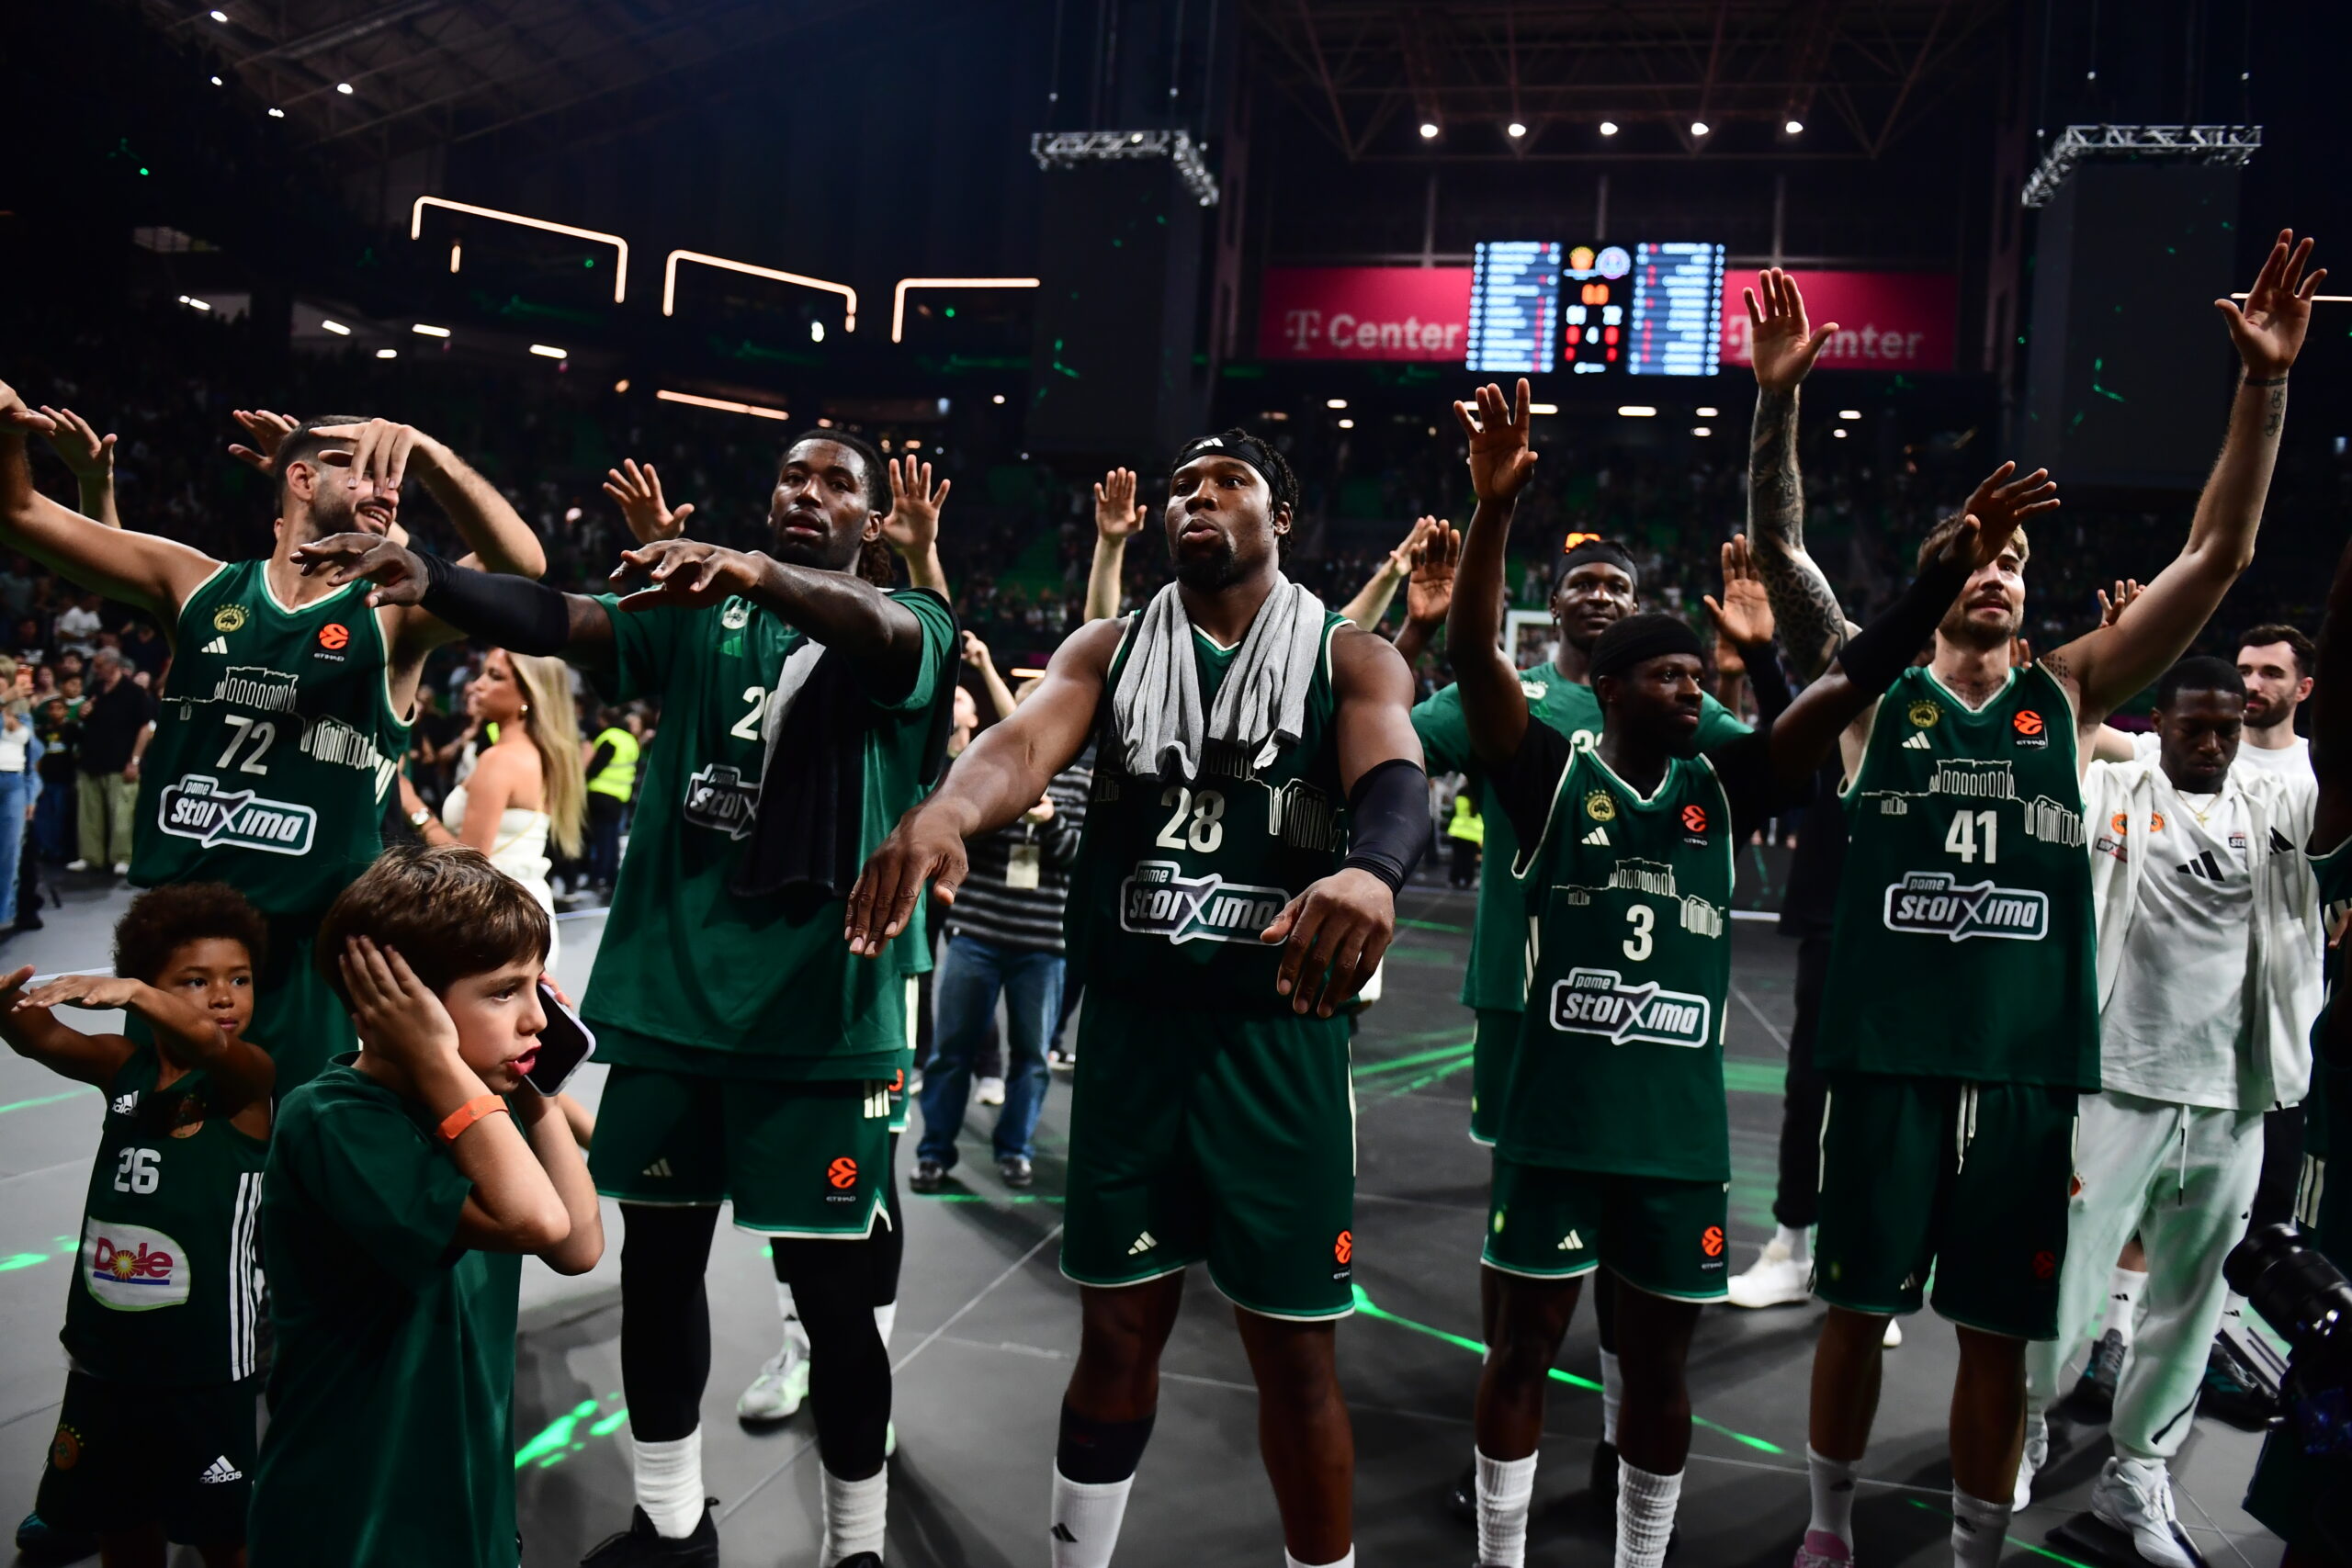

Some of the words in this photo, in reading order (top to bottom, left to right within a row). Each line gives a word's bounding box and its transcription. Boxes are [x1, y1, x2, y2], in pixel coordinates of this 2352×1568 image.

[1329, 313, 1462, 350] Center
[730, 686, 777, 741] 2
[216, 714, 276, 775] 72
[185, 782, 210, 795] pame
[1156, 786, 1225, 853] 28
[1945, 810, 1997, 863] 41
[1137, 868, 1170, 884] pame
[1909, 878, 1946, 891] pame
[1623, 905, 1655, 961] 3
[1575, 976, 1611, 989] pame
[114, 1146, 161, 1194] 26
[95, 1236, 173, 1279] Dole
[199, 1471, 243, 1483] adidas
